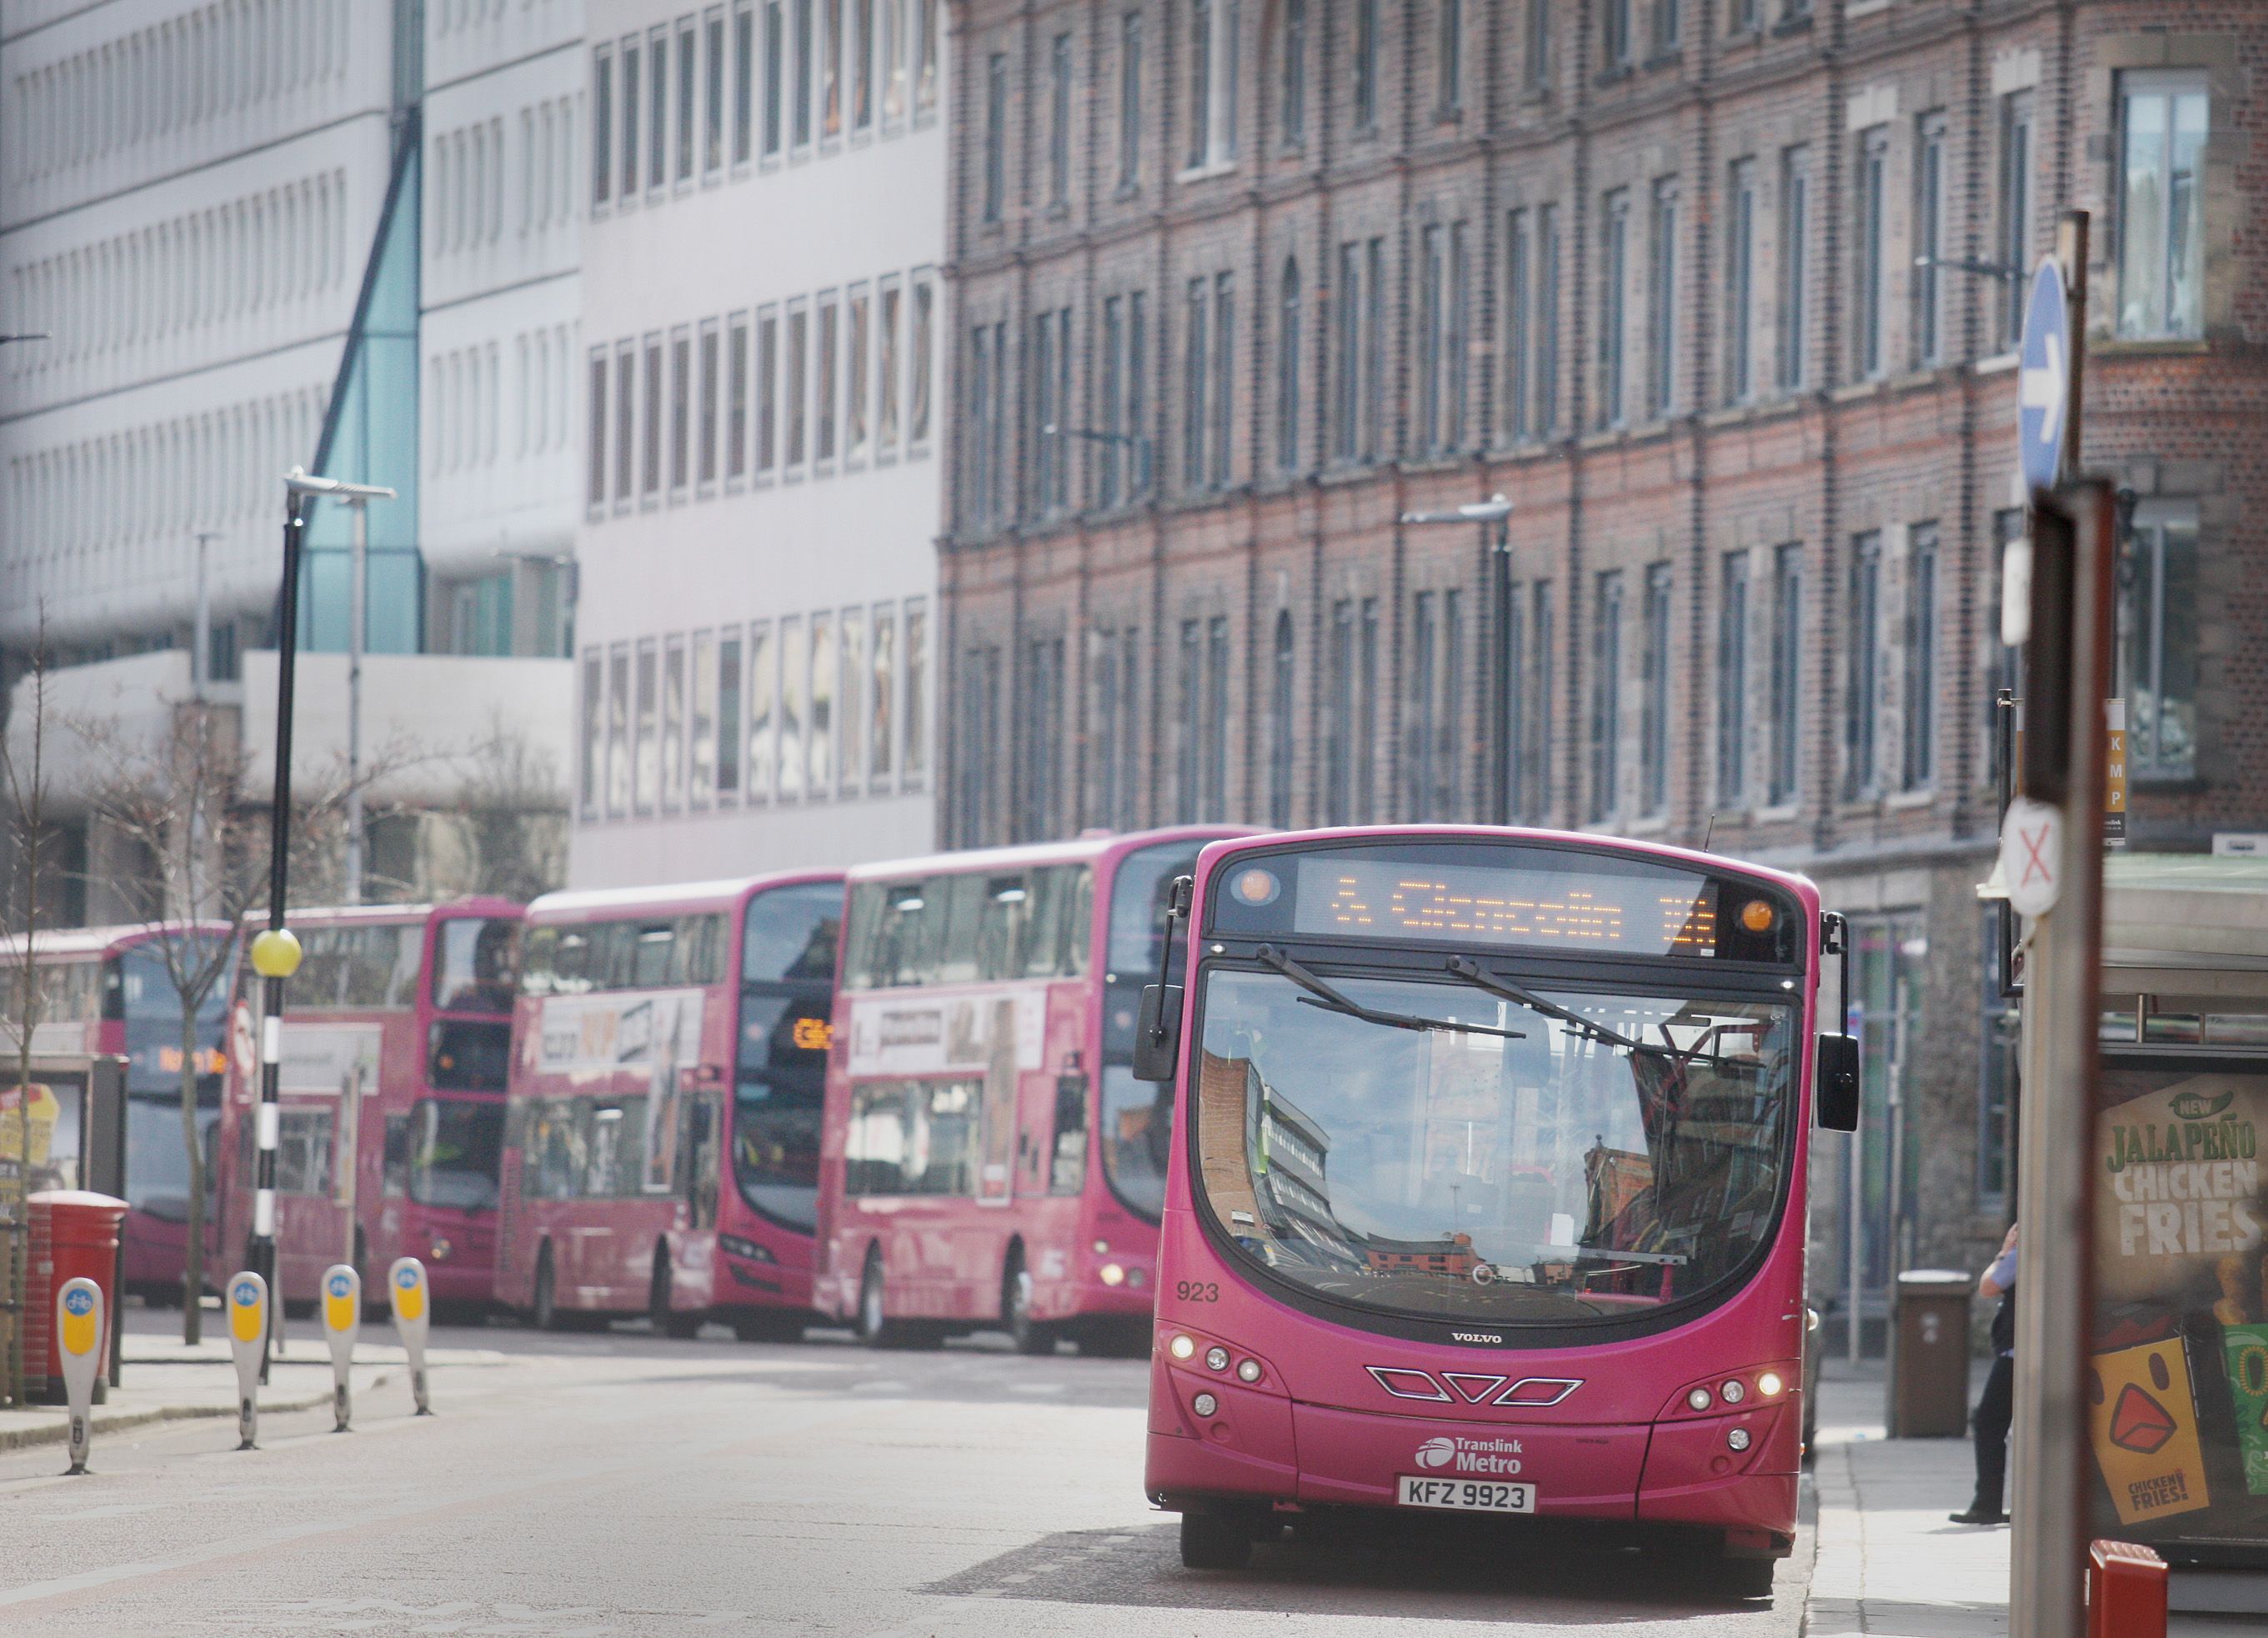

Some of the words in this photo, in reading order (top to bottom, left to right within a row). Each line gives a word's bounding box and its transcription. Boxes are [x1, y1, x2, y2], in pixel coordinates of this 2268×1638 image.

[2111, 737, 2121, 750] K
[2110, 764, 2122, 778] M
[2111, 792, 2121, 805] P
[2180, 1100, 2212, 1115] NEW
[2106, 1113, 2256, 1173] JALAPEÑO
[2114, 1160, 2258, 1202] CHICKEN
[2120, 1199, 2262, 1256] FRIES
[1177, 1280, 1219, 1303] 923
[1451, 1332, 1503, 1344] VOLVO
[1455, 1437, 1523, 1454] Translink
[1455, 1451, 1522, 1475] Metro
[1409, 1480, 1455, 1505] KFZ
[1463, 1484, 1525, 1510] 9923
[2128, 1474, 2177, 1495] CHICKEN
